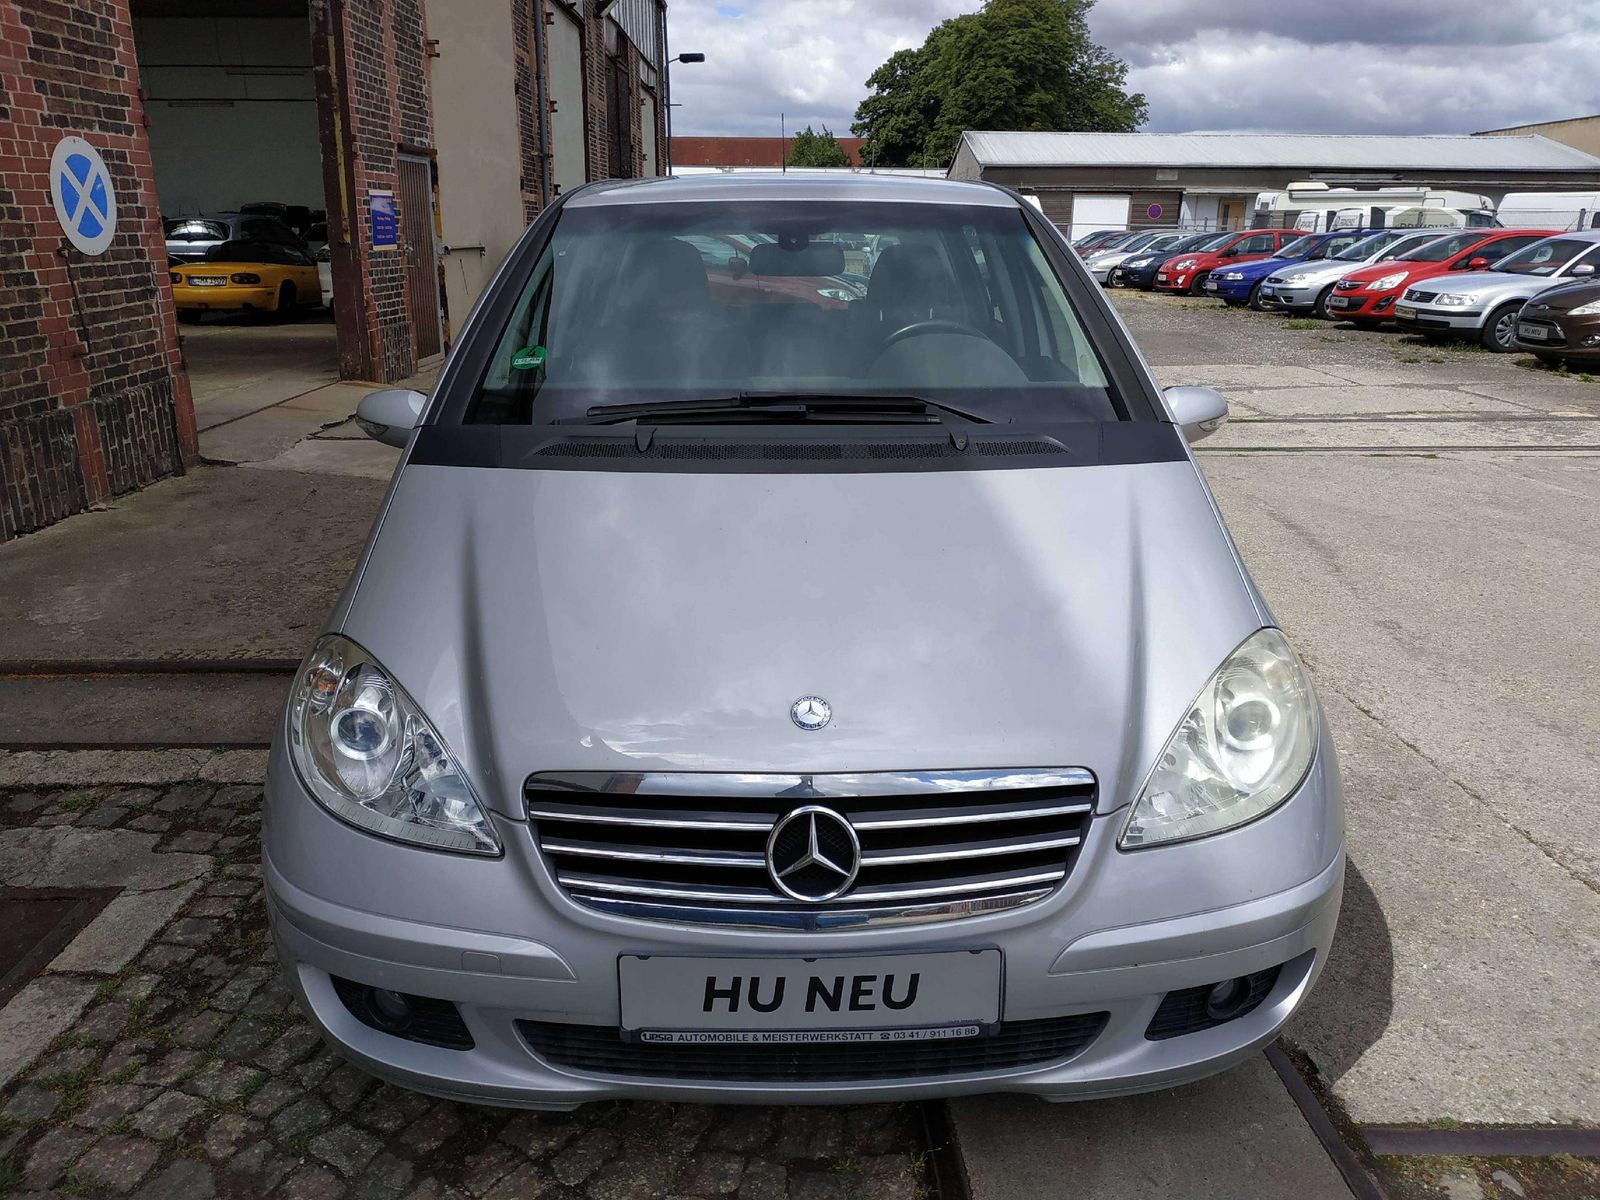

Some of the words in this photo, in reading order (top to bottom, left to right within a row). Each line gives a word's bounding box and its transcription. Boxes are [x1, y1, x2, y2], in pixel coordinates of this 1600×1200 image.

[703, 976, 785, 1013] HU
[805, 973, 920, 1012] NEU
[677, 1033, 749, 1043] AUTOMOBILE
[752, 1033, 760, 1042] &
[762, 1032, 874, 1043] MEISTERWERKSTATT
[893, 1031, 906, 1040] 03
[908, 1031, 920, 1039] 41
[929, 1029, 947, 1038] 911
[950, 1028, 962, 1037] 16
[964, 1027, 977, 1037] 86
